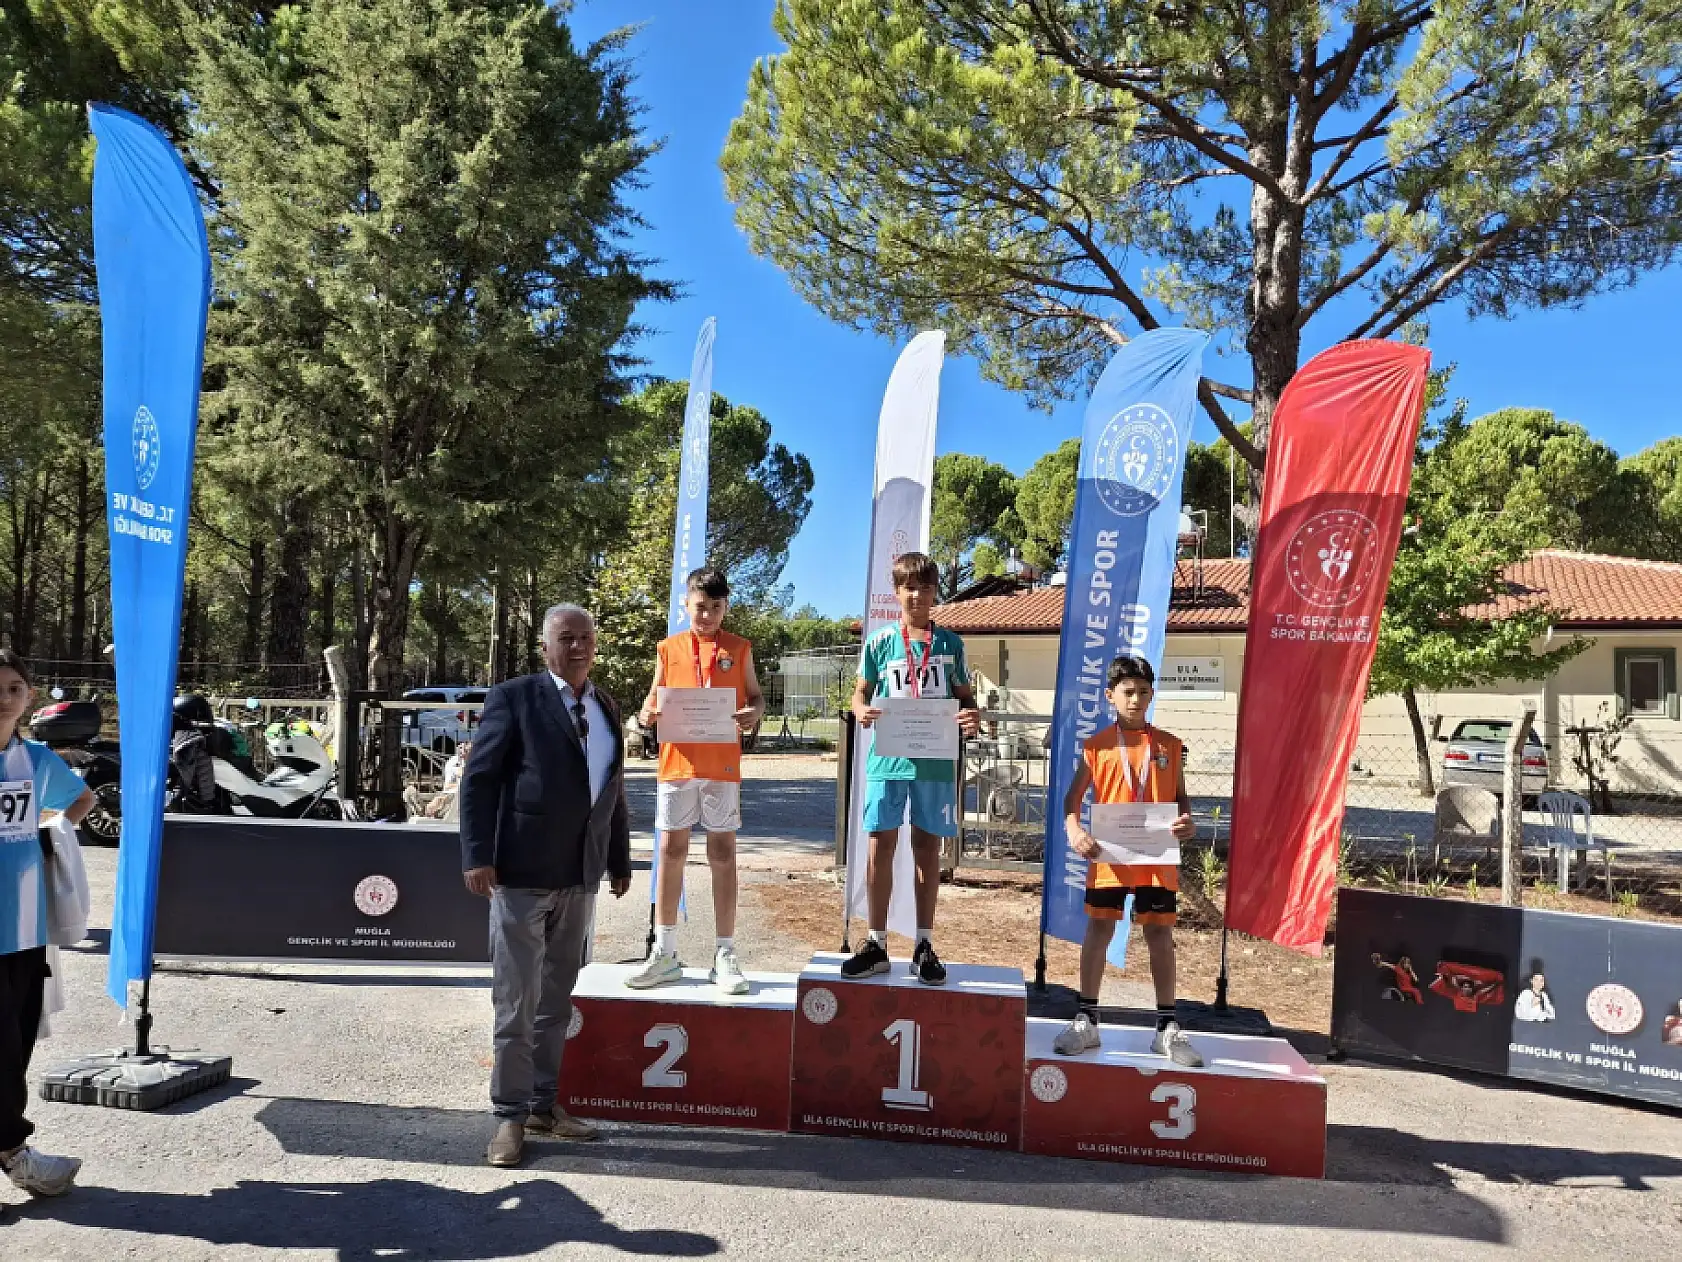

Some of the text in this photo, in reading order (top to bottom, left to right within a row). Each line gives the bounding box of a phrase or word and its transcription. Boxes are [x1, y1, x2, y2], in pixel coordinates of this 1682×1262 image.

[1089, 529, 1120, 608] SPOR
[1085, 613, 1109, 649] VE
[1270, 627, 1305, 641] SPOR
[1, 793, 32, 823] 97
[287, 936, 456, 949] GENÇLİK VE SPOR İL MÜDÜRLÜĞÜ
[354, 926, 391, 936] MUĞLA
[642, 1022, 689, 1088] 2
[881, 1018, 934, 1112] 1
[1508, 1042, 1563, 1061] GENÇLİK
[1565, 1052, 1582, 1064] VE
[1585, 1055, 1620, 1070] SPOR
[1622, 1059, 1637, 1073] İL
[1589, 1042, 1637, 1059] MUĞLA
[570, 1095, 757, 1118] ULA GENÇLİK VE SPOR İLÇE MÜDÜRLÜĞÜ
[1150, 1081, 1197, 1140] 3
[803, 1114, 823, 1126] ULA
[825, 1116, 870, 1130] GENÇLİK
[871, 1121, 886, 1132] VE
[886, 1121, 915, 1134] SPOR
[941, 1126, 1008, 1144] MÜDÜRLÜĞÜ
[1077, 1141, 1267, 1167] ULA GENÇLİK VE SPOR İLÇE MÜDÜRLÜĞÜ
